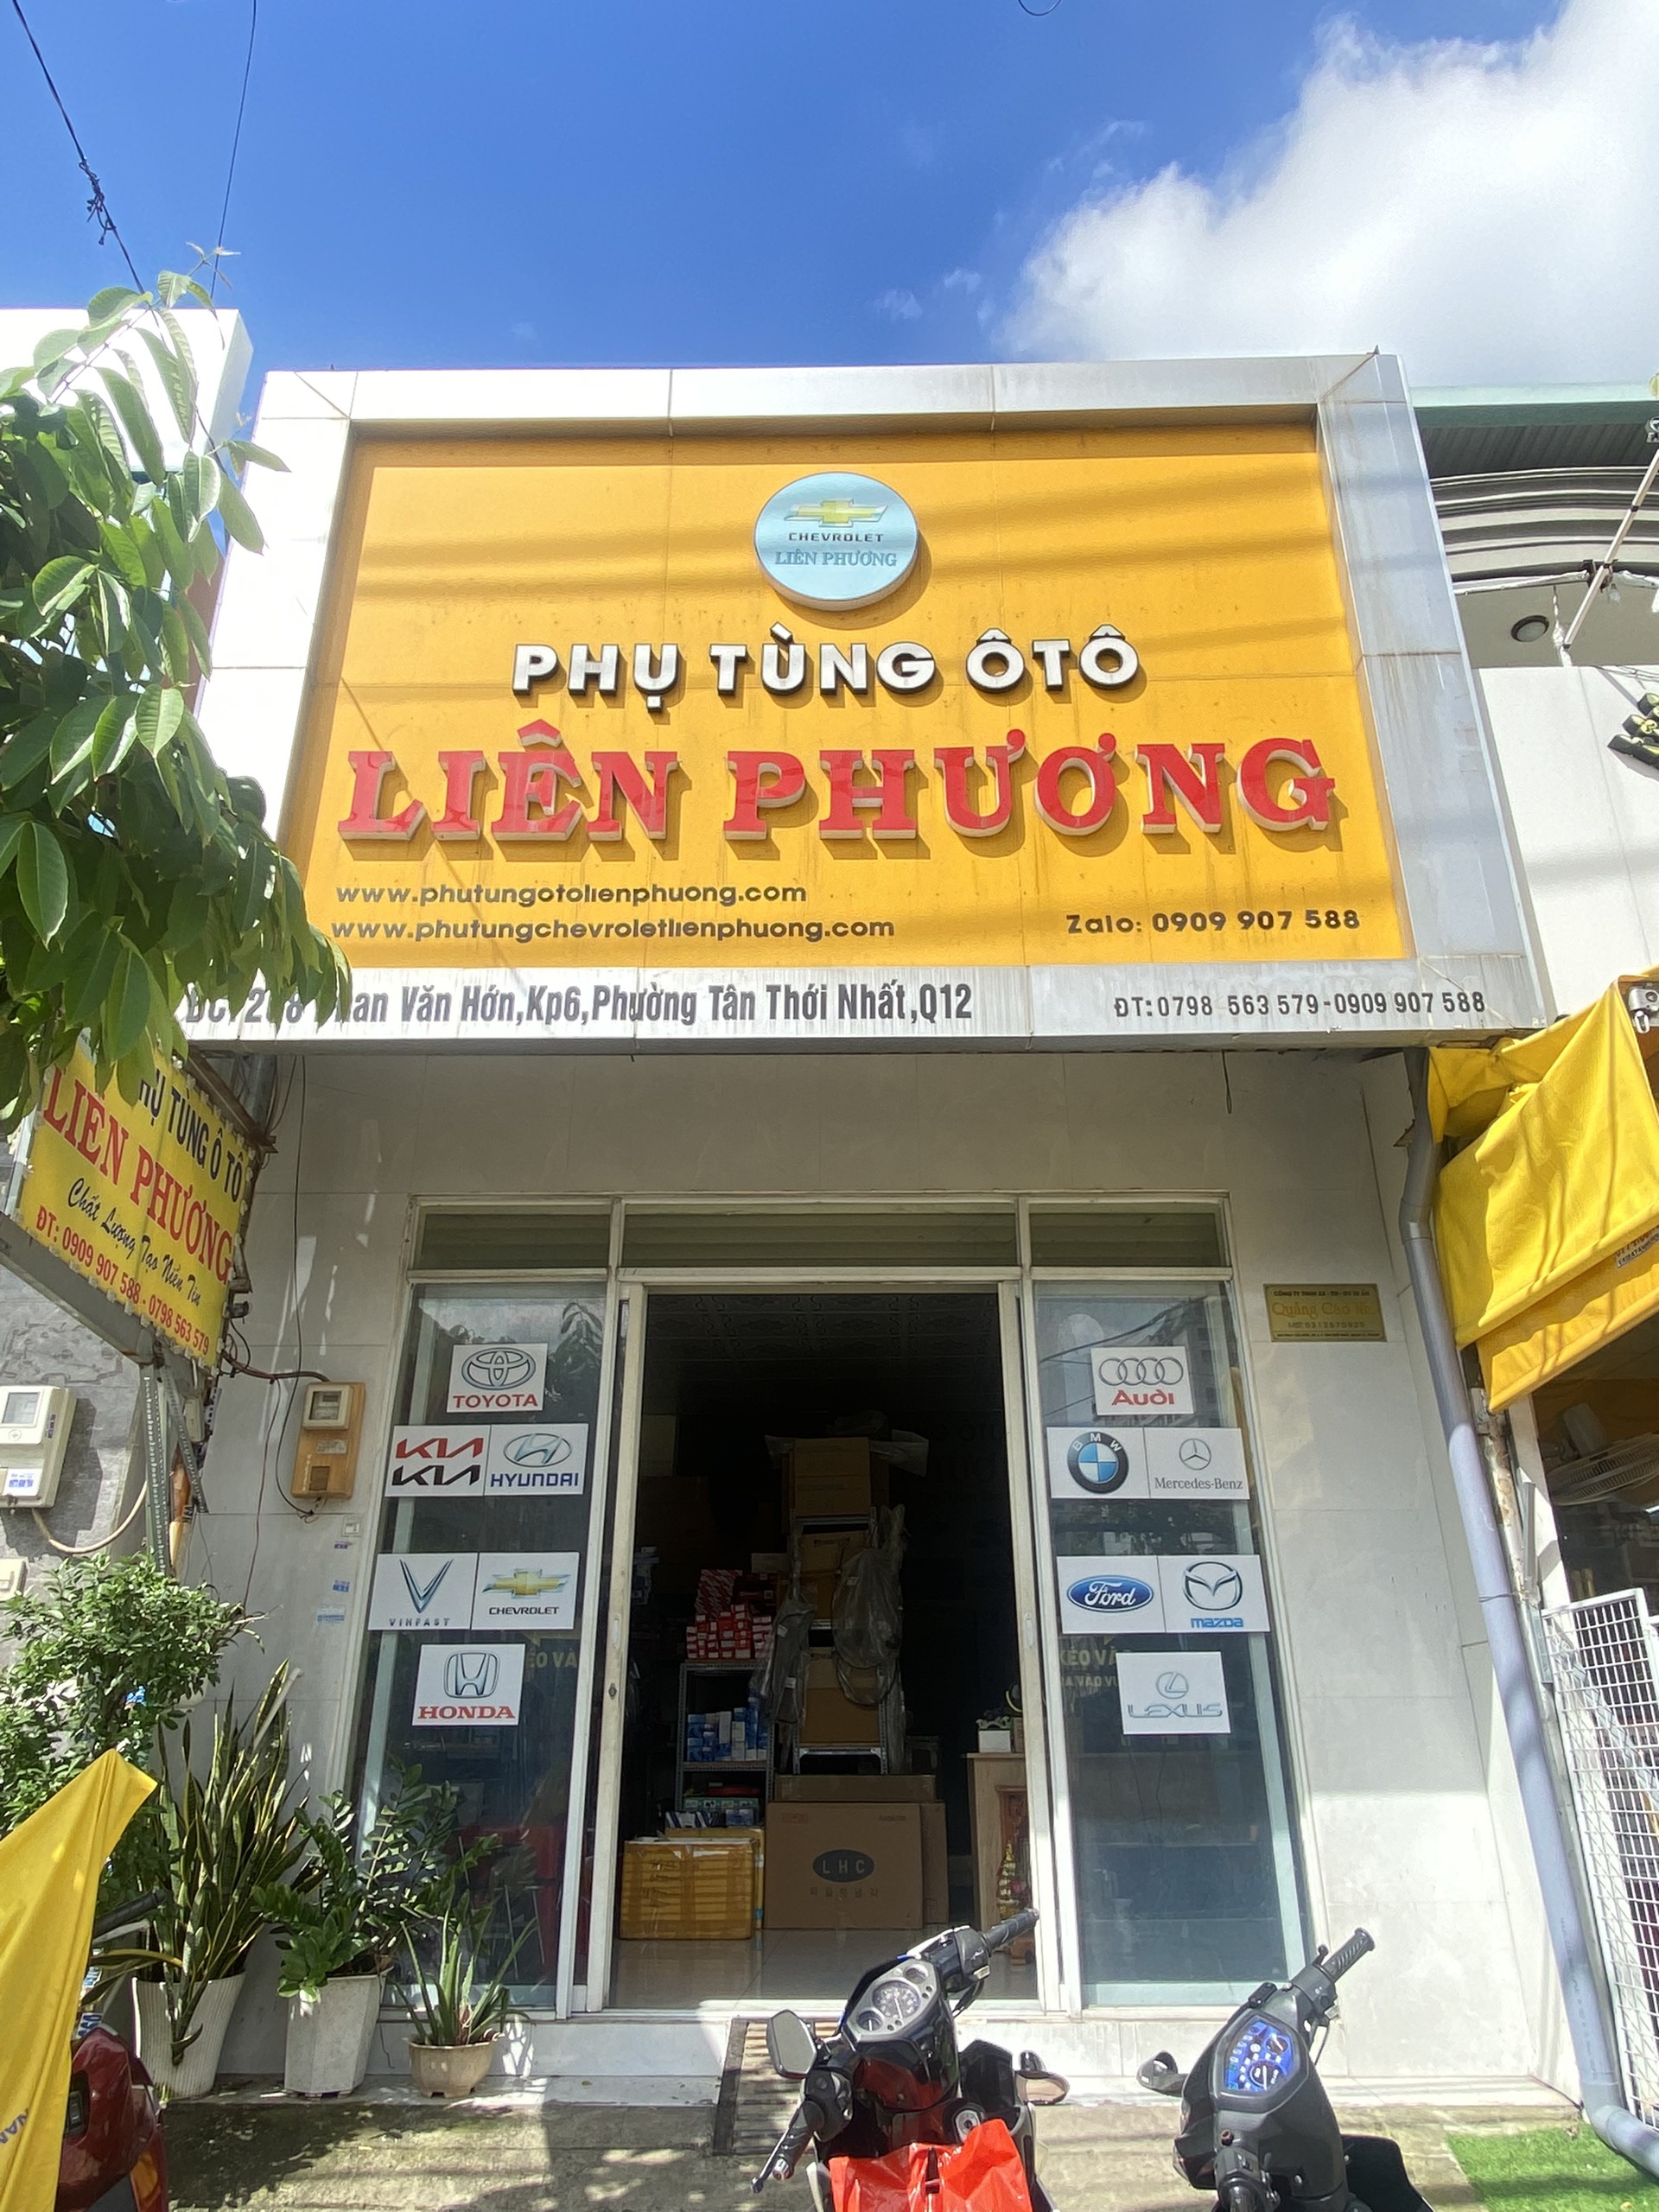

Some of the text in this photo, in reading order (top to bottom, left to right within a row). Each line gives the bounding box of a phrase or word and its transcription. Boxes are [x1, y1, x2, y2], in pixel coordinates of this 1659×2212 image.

[788, 532, 884, 543] CHEVROLET
[775, 548, 898, 567] LIÊN PHƯƠNG
[512, 622, 1139, 711] PHỤ TÙNG ÔTÔ
[338, 719, 1336, 841] LIÊN PHƯƠNG
[335, 883, 807, 908] www.phutungotolienphuong.com
[331, 918, 895, 944] www.phutungchevroletlienphuong.com
[1065, 909, 1361, 934] Zalo: 0909 907 588
[244, 987, 302, 1024] 28
[401, 984, 452, 1023] Văn
[708, 983, 756, 1021] Tân
[766, 982, 828, 1020] Thới
[1113, 990, 1486, 1018] ĐT:0798 563 579-0909 907 588
[168, 1085, 209, 1169] TÙNG
[210, 1127, 223, 1180] Ô
[224, 1150, 244, 1203] TÔ
[67, 1177, 101, 1222] Chất
[100, 1206, 136, 1261] Lượng
[141, 1235, 158, 1274] Tạo
[130, 1144, 233, 1286] PHƯƠNG
[35, 1205, 210, 1356] ĐT: 0909 907 588 0798 563 579
[452, 1394, 539, 1408] TOYOTA
[1111, 1389, 1175, 1406] Audi
[1071, 1432, 1122, 1452] BMW
[490, 1472, 579, 1488] HYUNDAI
[1154, 1476, 1244, 1491] Mercedes-Benz
[1084, 1580, 1138, 1607] Ford
[487, 1605, 560, 1616] CHEVROLET
[388, 1617, 451, 1628] VINFAST
[416, 1705, 517, 1720] HONDA
[1127, 1702, 1224, 1719] LEXUS
[821, 1859, 866, 1875] LHC
